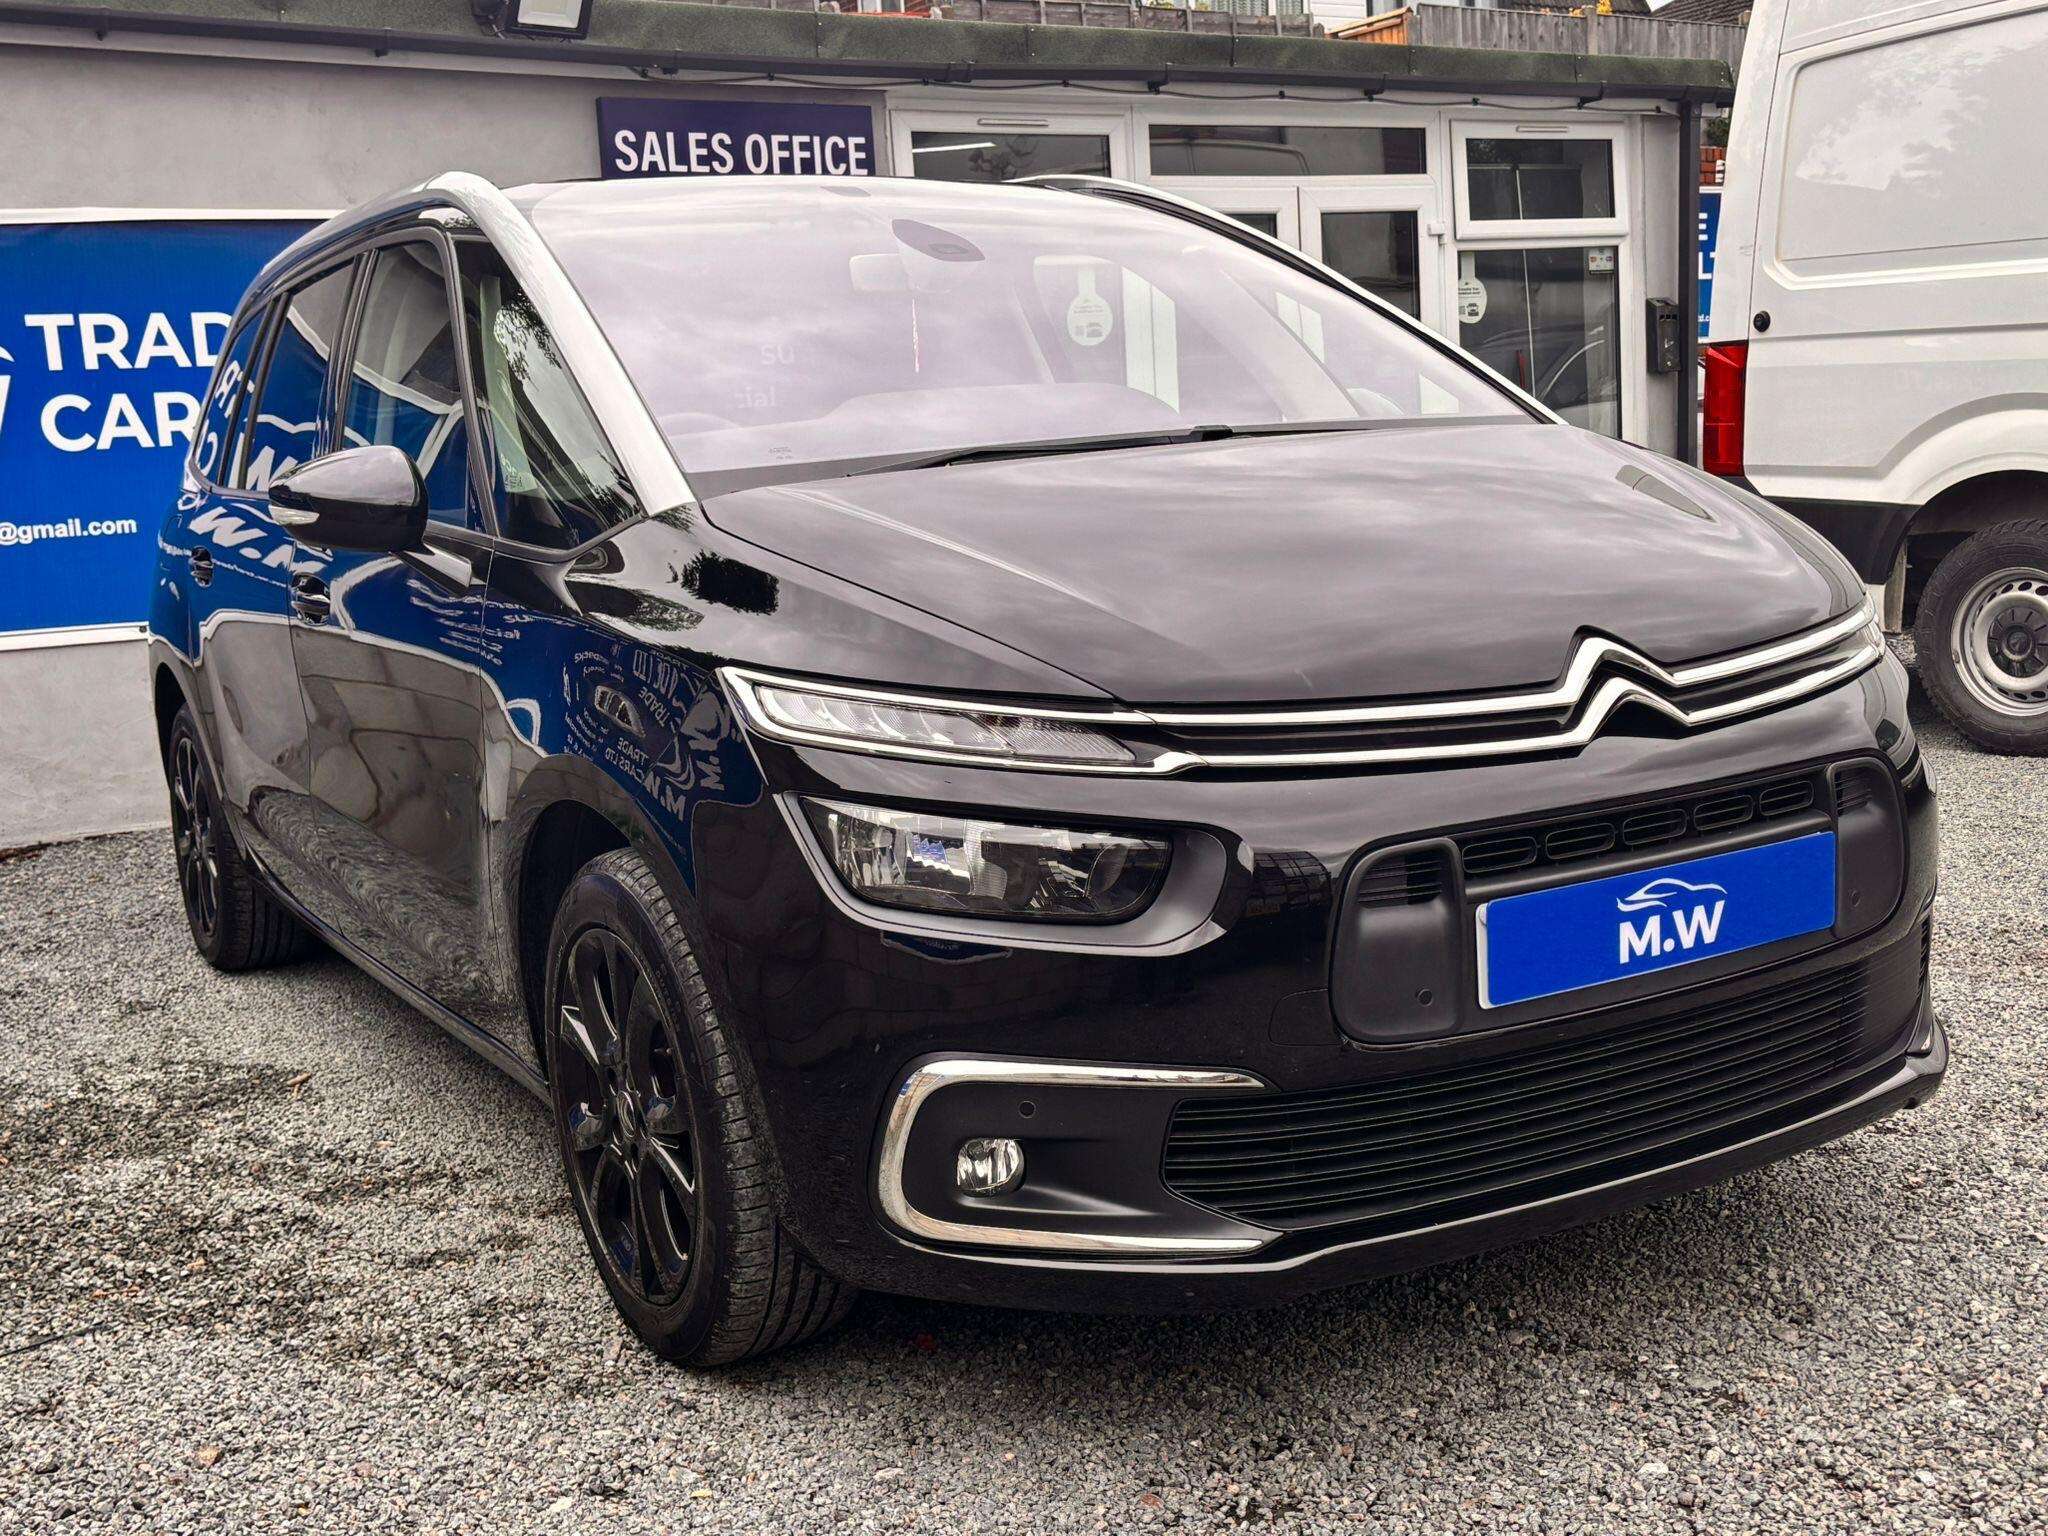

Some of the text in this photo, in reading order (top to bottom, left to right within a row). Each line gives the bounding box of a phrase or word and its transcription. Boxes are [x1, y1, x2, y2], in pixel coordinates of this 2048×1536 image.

[615, 129, 869, 176] SALES OFFICE
[1619, 900, 1726, 964] M.W
